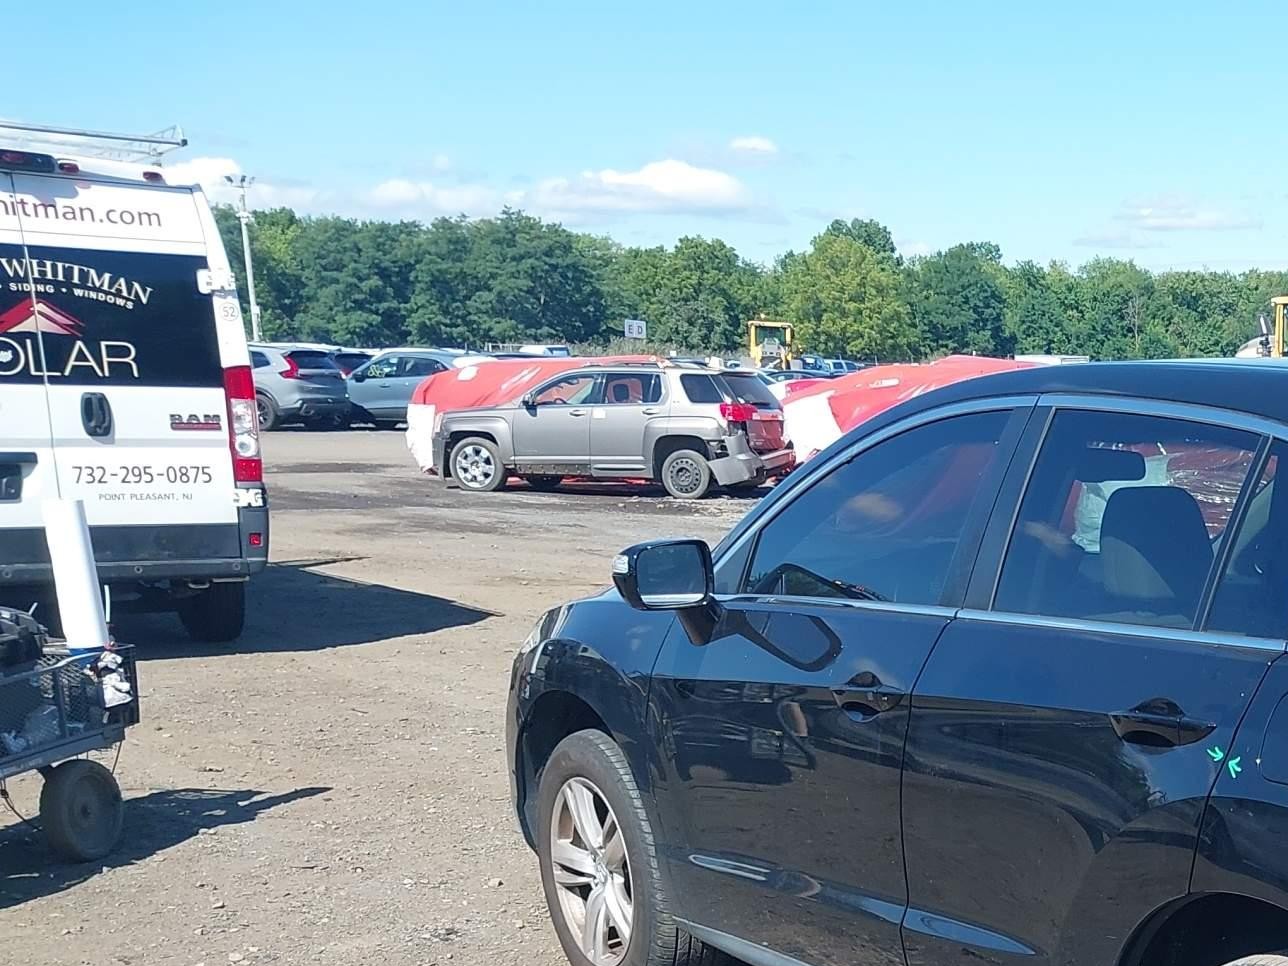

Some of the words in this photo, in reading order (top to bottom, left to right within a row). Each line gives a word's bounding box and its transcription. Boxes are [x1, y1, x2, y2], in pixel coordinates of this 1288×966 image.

[0, 257, 154, 306] WHITMAN
[9, 282, 55, 294] SIDING
[73, 287, 135, 310] WINDOWS
[222, 306, 236, 318] 52
[72, 466, 213, 484] 732-295-0875
[98, 493, 126, 501] POINT
[130, 493, 180, 502] PLEASANT,
[182, 493, 193, 501] NJ
